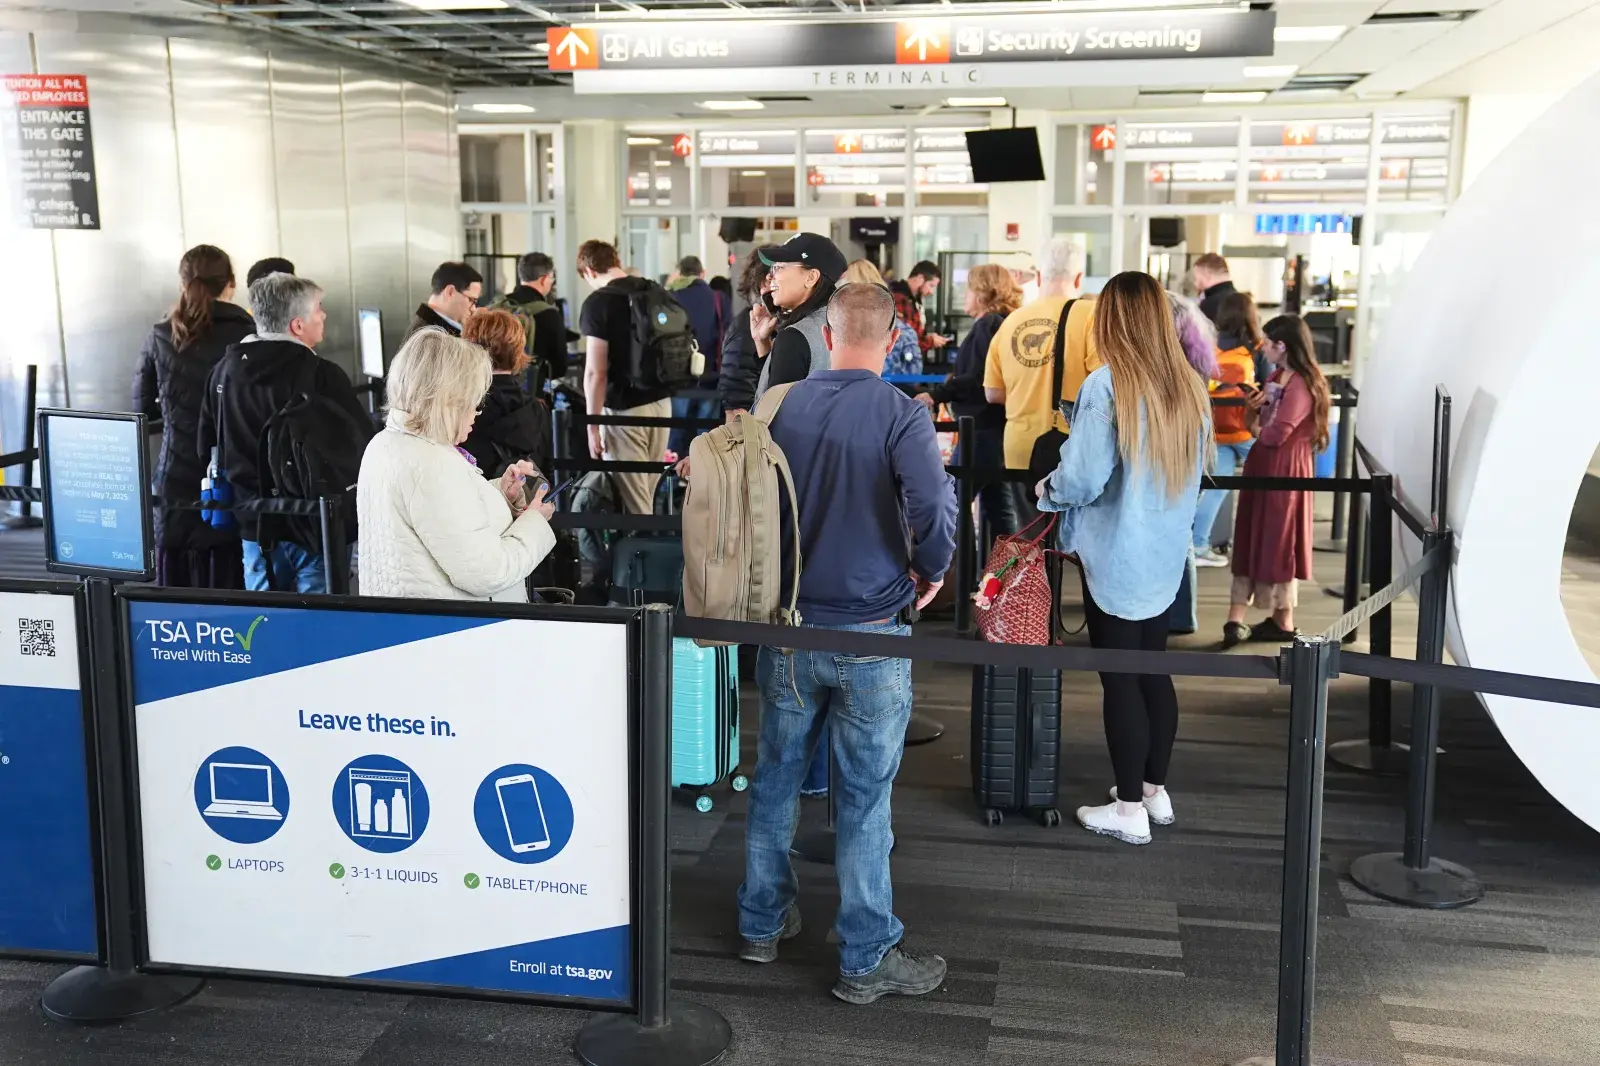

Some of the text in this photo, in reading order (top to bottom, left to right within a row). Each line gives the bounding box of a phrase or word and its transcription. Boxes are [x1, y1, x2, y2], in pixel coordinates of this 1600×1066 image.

[633, 37, 729, 57] All Gates
[988, 25, 1201, 54] Security Screening
[44, 78, 62, 89] ALL
[63, 79, 83, 90] PHL
[812, 69, 977, 85] TERMINAL C
[32, 91, 86, 103] EMPLOYEES
[20, 110, 86, 125] ENTRANCE
[22, 127, 48, 140] THIS
[51, 127, 84, 141] GATE
[91, 490, 105, 500] May
[112, 492, 129, 501] 2025
[145, 619, 191, 644] TSA
[151, 647, 252, 664] Travel With Ease
[298, 709, 456, 737] Leave these in.
[228, 858, 285, 873] LAPTOPS
[350, 866, 438, 884] 3-1-1 LIQUIDS
[486, 876, 588, 896] TABLET/PHONE
[509, 960, 612, 980] Enroll at tsa.gov
